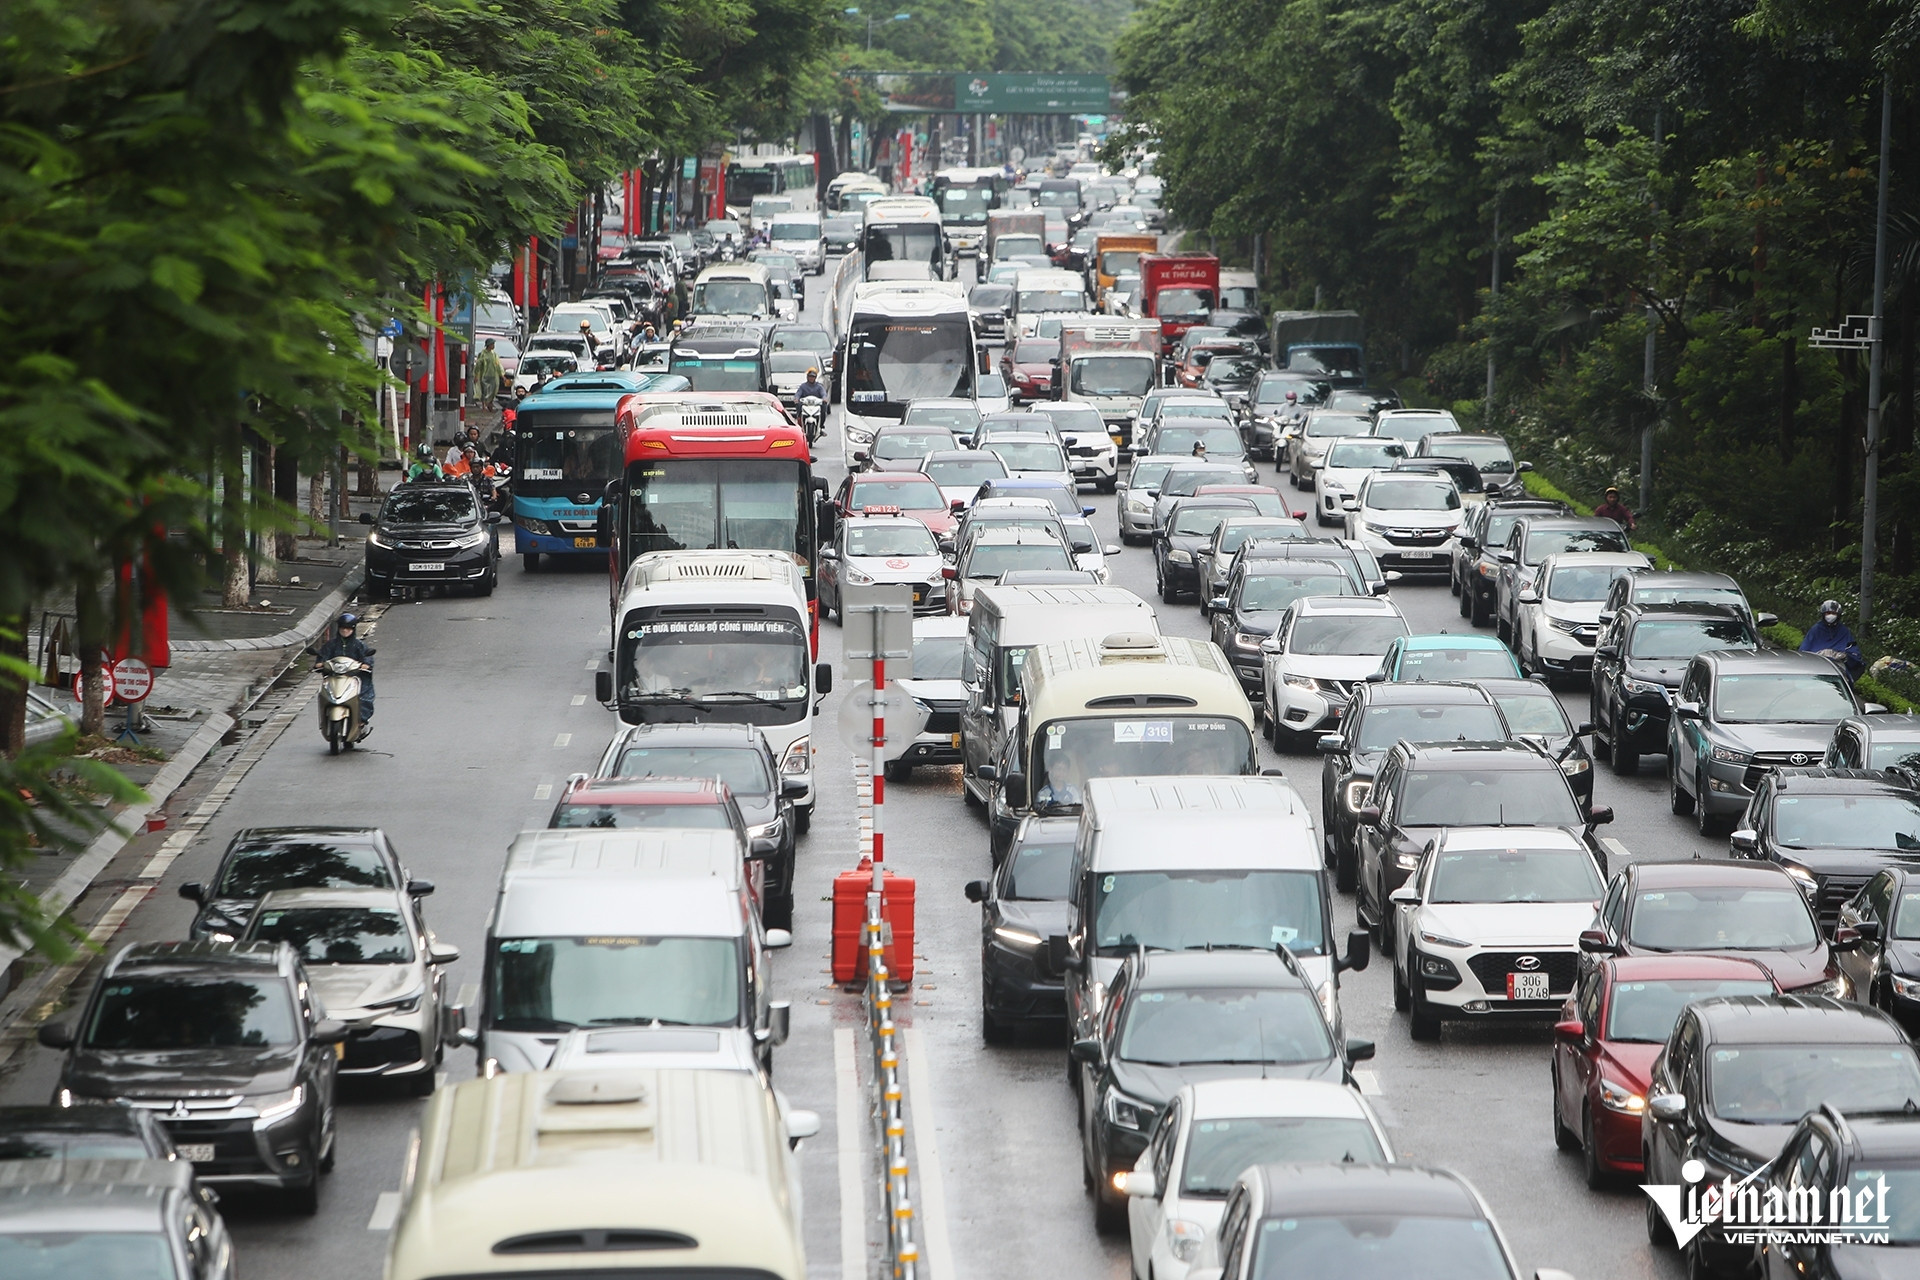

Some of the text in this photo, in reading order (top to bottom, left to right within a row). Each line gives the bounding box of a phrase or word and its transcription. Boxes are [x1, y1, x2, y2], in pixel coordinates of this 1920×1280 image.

[641, 624, 652, 633] XE
[688, 621, 705, 632] CÁN
[707, 621, 718, 633] BỘ
[719, 621, 741, 632] CÔNG
[742, 621, 765, 632] NHÂN
[766, 621, 784, 633] VIÊN
[1147, 726, 1169, 737] 316
[1188, 721, 1226, 732] XE HỢP ĐỒNG
[1522, 975, 1541, 987] 30G
[1515, 987, 1549, 999] 012.48
